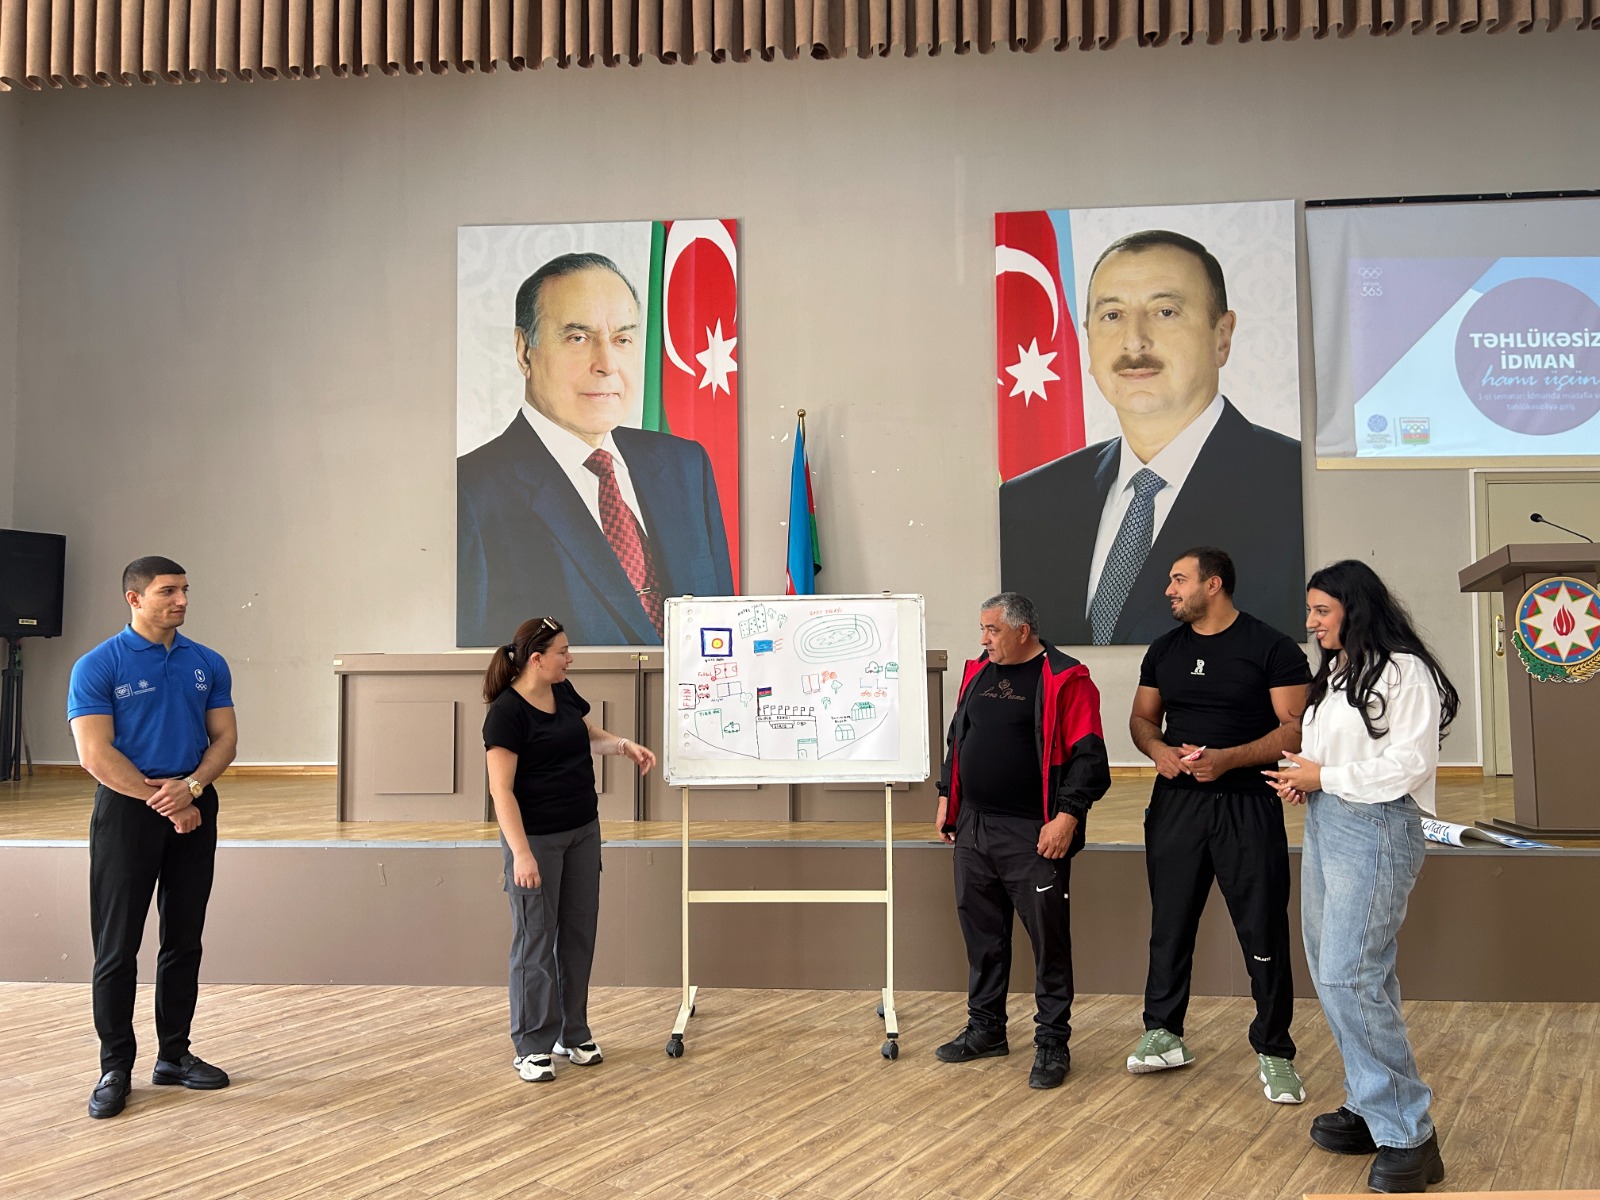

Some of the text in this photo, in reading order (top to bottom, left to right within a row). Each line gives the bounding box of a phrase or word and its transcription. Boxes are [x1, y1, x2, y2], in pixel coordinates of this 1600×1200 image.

[1361, 286, 1383, 296] 365
[1469, 328, 1600, 348] TƏHLÜKƏSİZ
[1500, 350, 1575, 369] İDMAN
